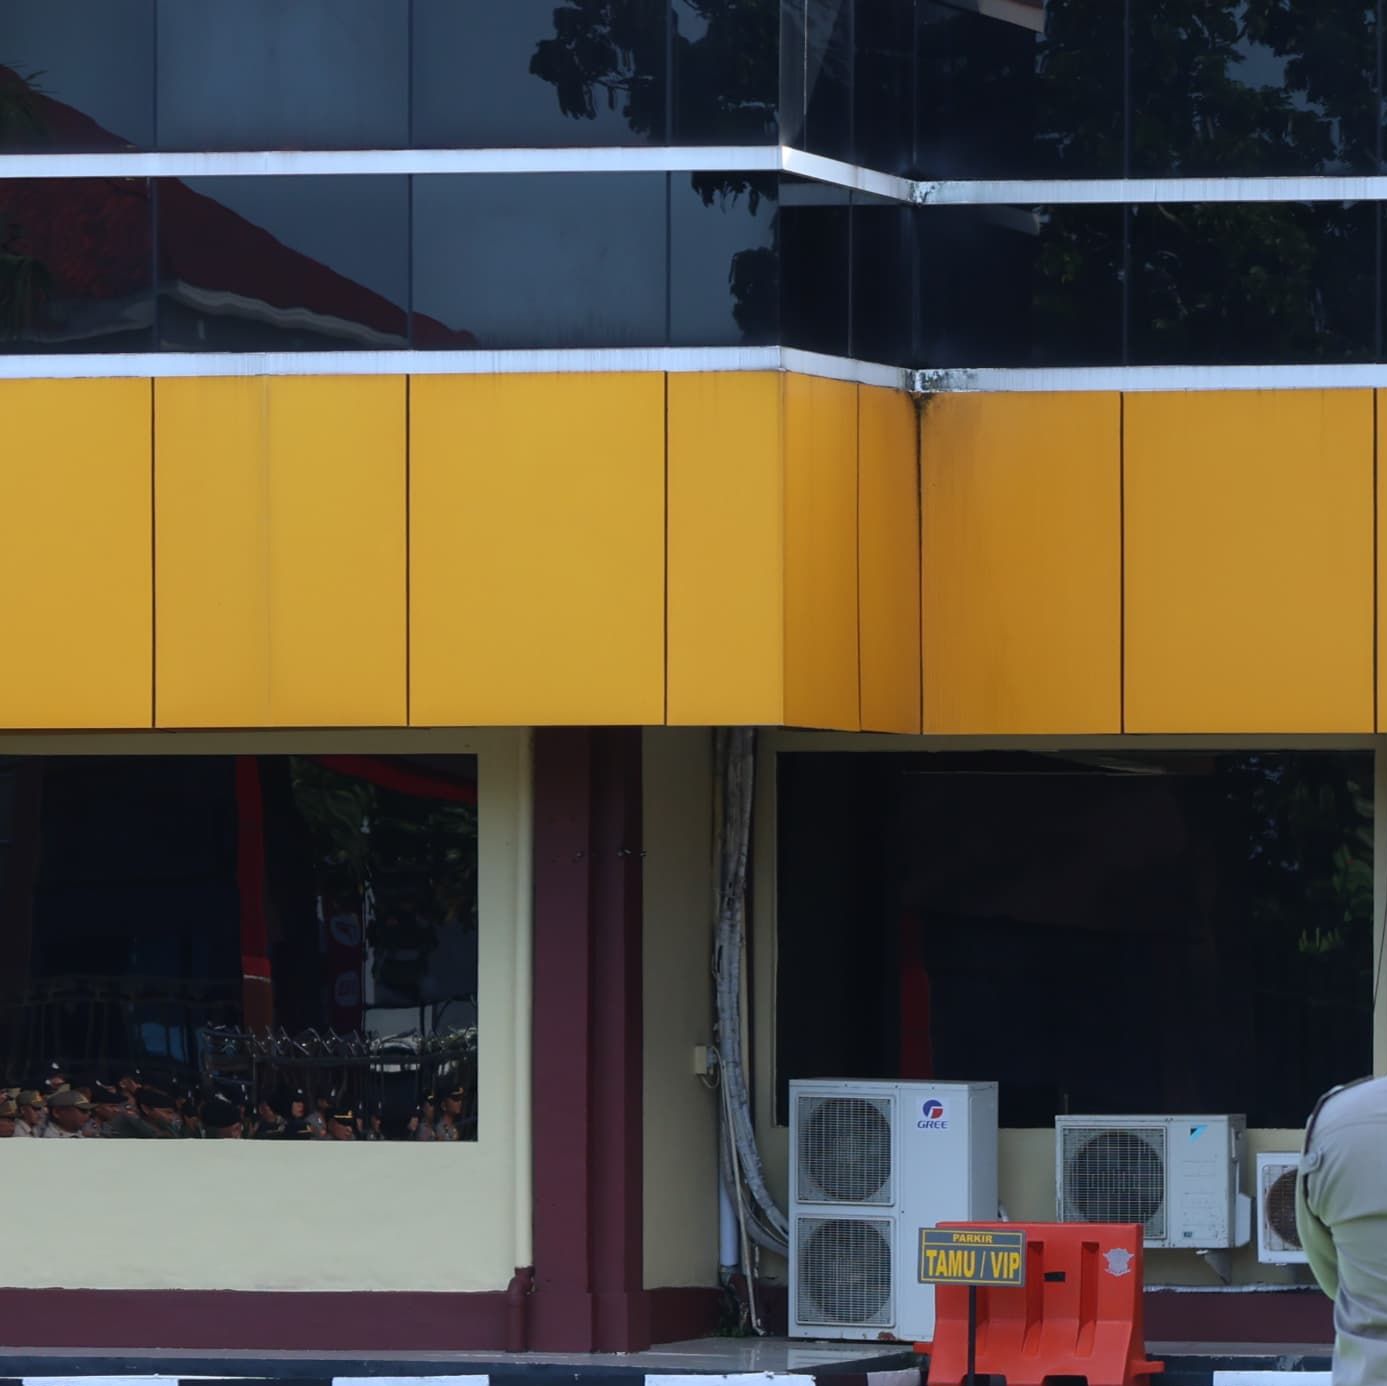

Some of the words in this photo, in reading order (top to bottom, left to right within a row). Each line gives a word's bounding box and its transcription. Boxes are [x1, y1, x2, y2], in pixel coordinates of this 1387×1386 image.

[917, 1120, 948, 1130] GREE
[952, 1232, 993, 1244] PARKIR
[925, 1249, 976, 1278] TAMU
[980, 1250, 987, 1279] /
[991, 1251, 1020, 1280] VIP
